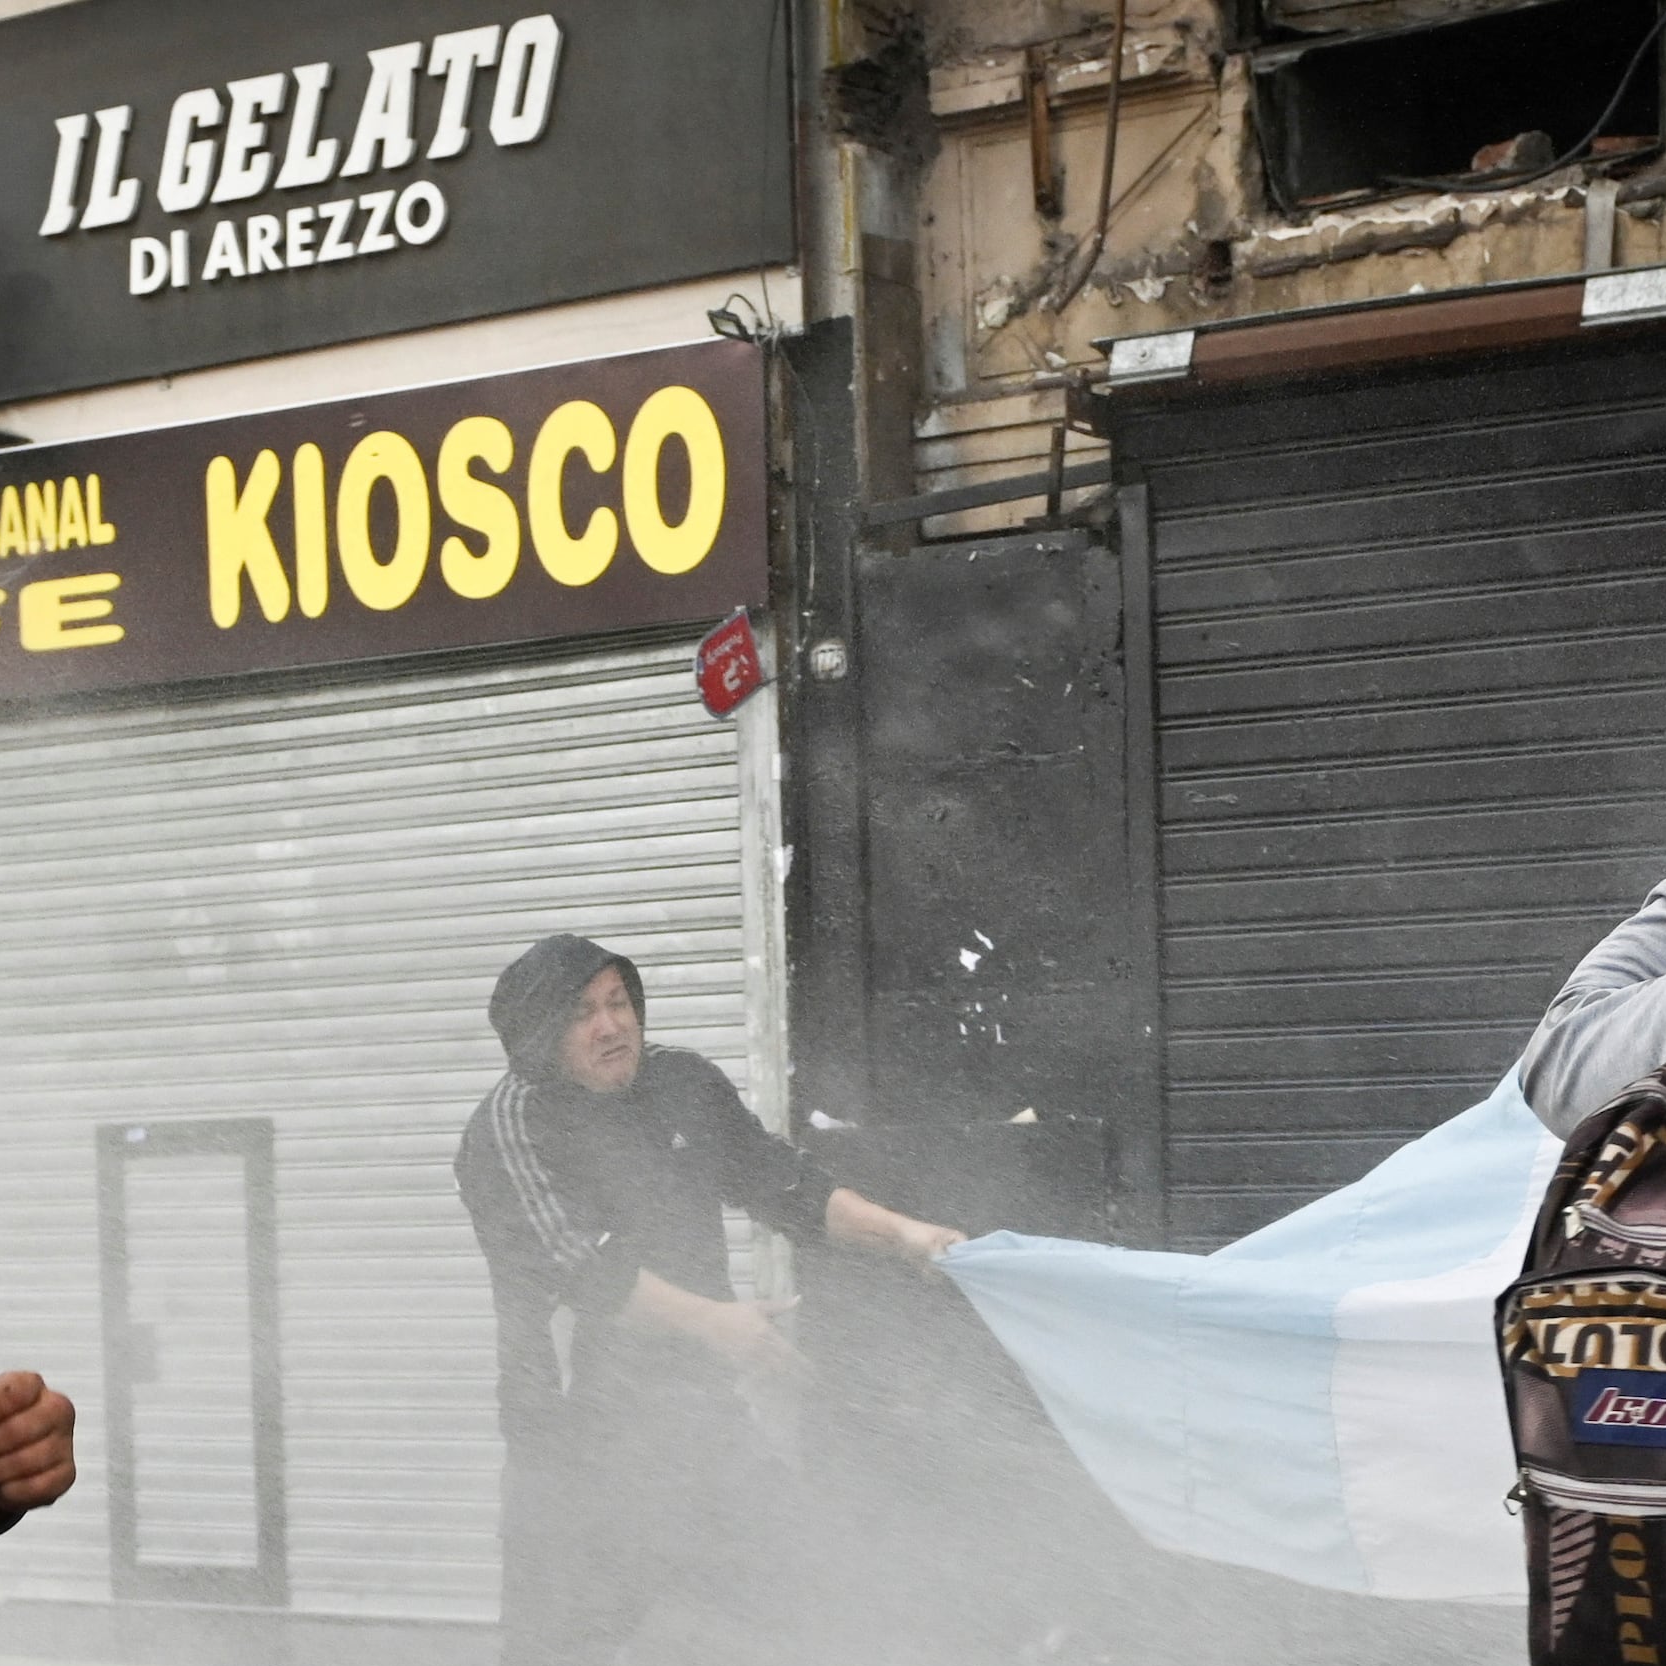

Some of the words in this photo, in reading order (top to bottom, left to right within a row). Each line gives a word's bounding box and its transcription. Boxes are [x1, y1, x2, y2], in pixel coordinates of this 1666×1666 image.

[40, 102, 142, 237] IL
[157, 13, 563, 215] GELATO
[129, 234, 191, 295] DI
[203, 178, 449, 282] AREZZO
[206, 384, 726, 629] KIOSCO
